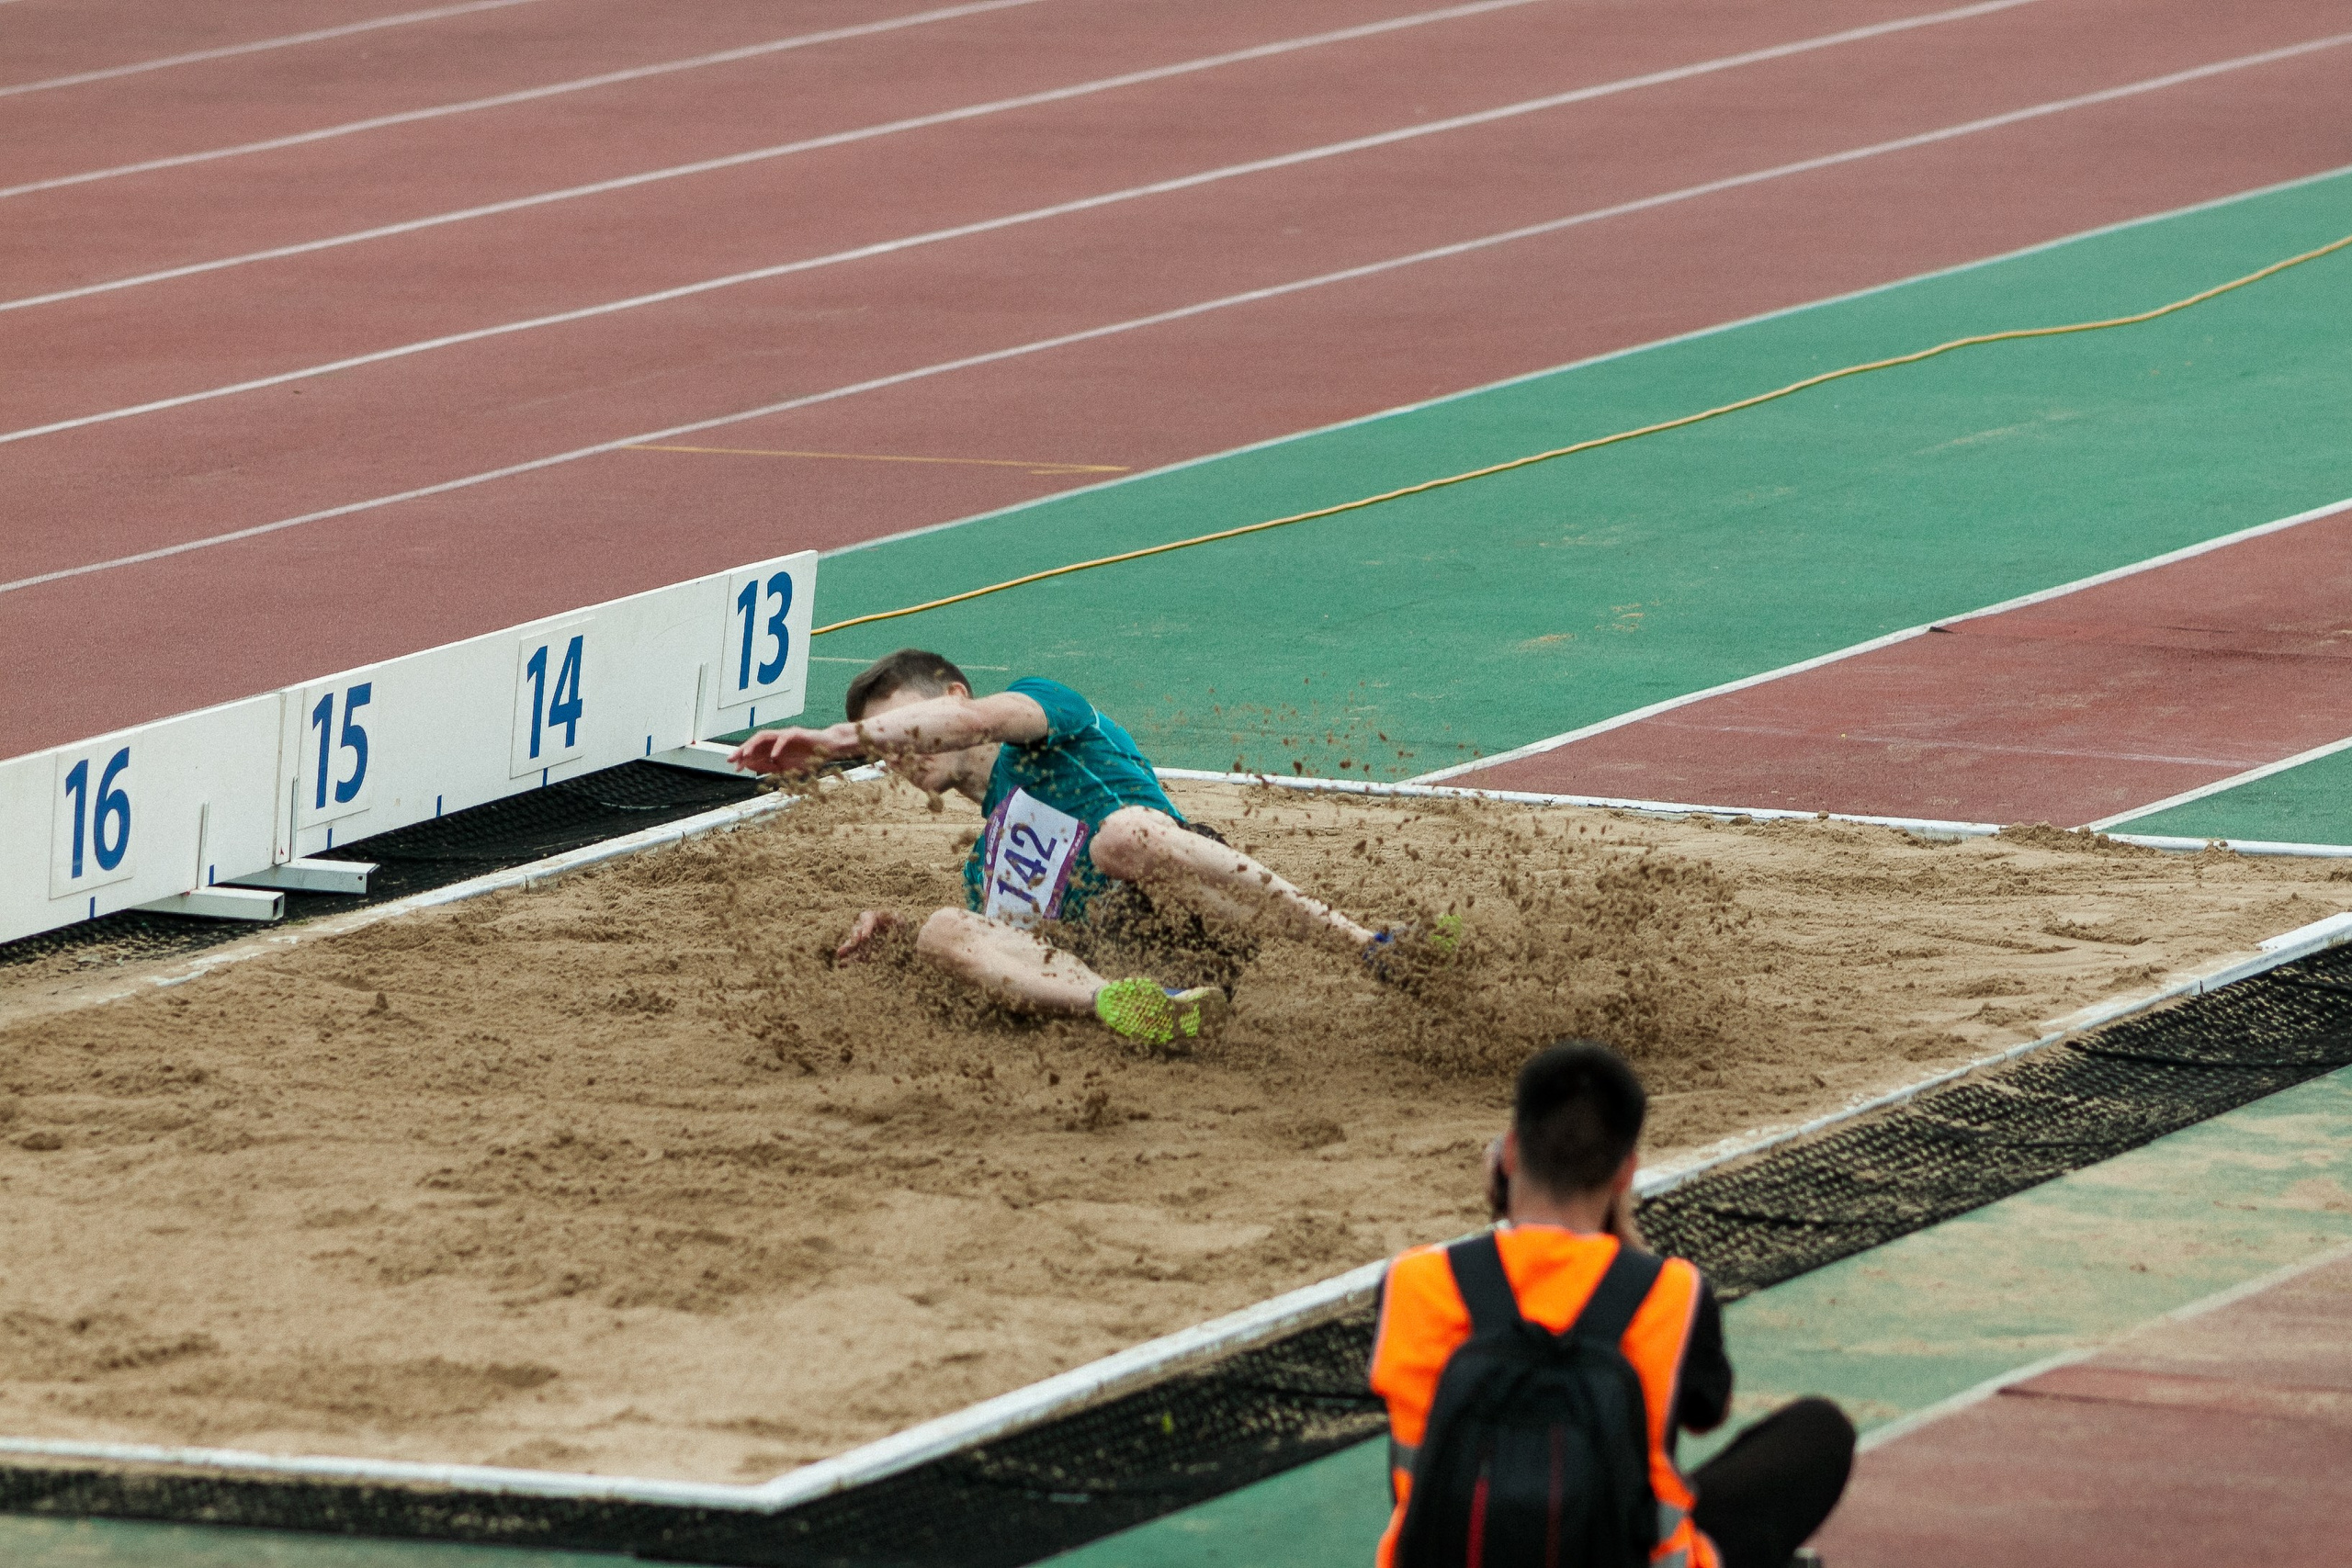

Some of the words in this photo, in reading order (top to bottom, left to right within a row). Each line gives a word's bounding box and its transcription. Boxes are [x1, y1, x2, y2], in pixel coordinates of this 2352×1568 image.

[737, 570, 794, 692] 13
[312, 682, 372, 809] 15
[526, 635, 583, 759] 14
[65, 748, 130, 877] 16
[997, 822, 1057, 908] 142
